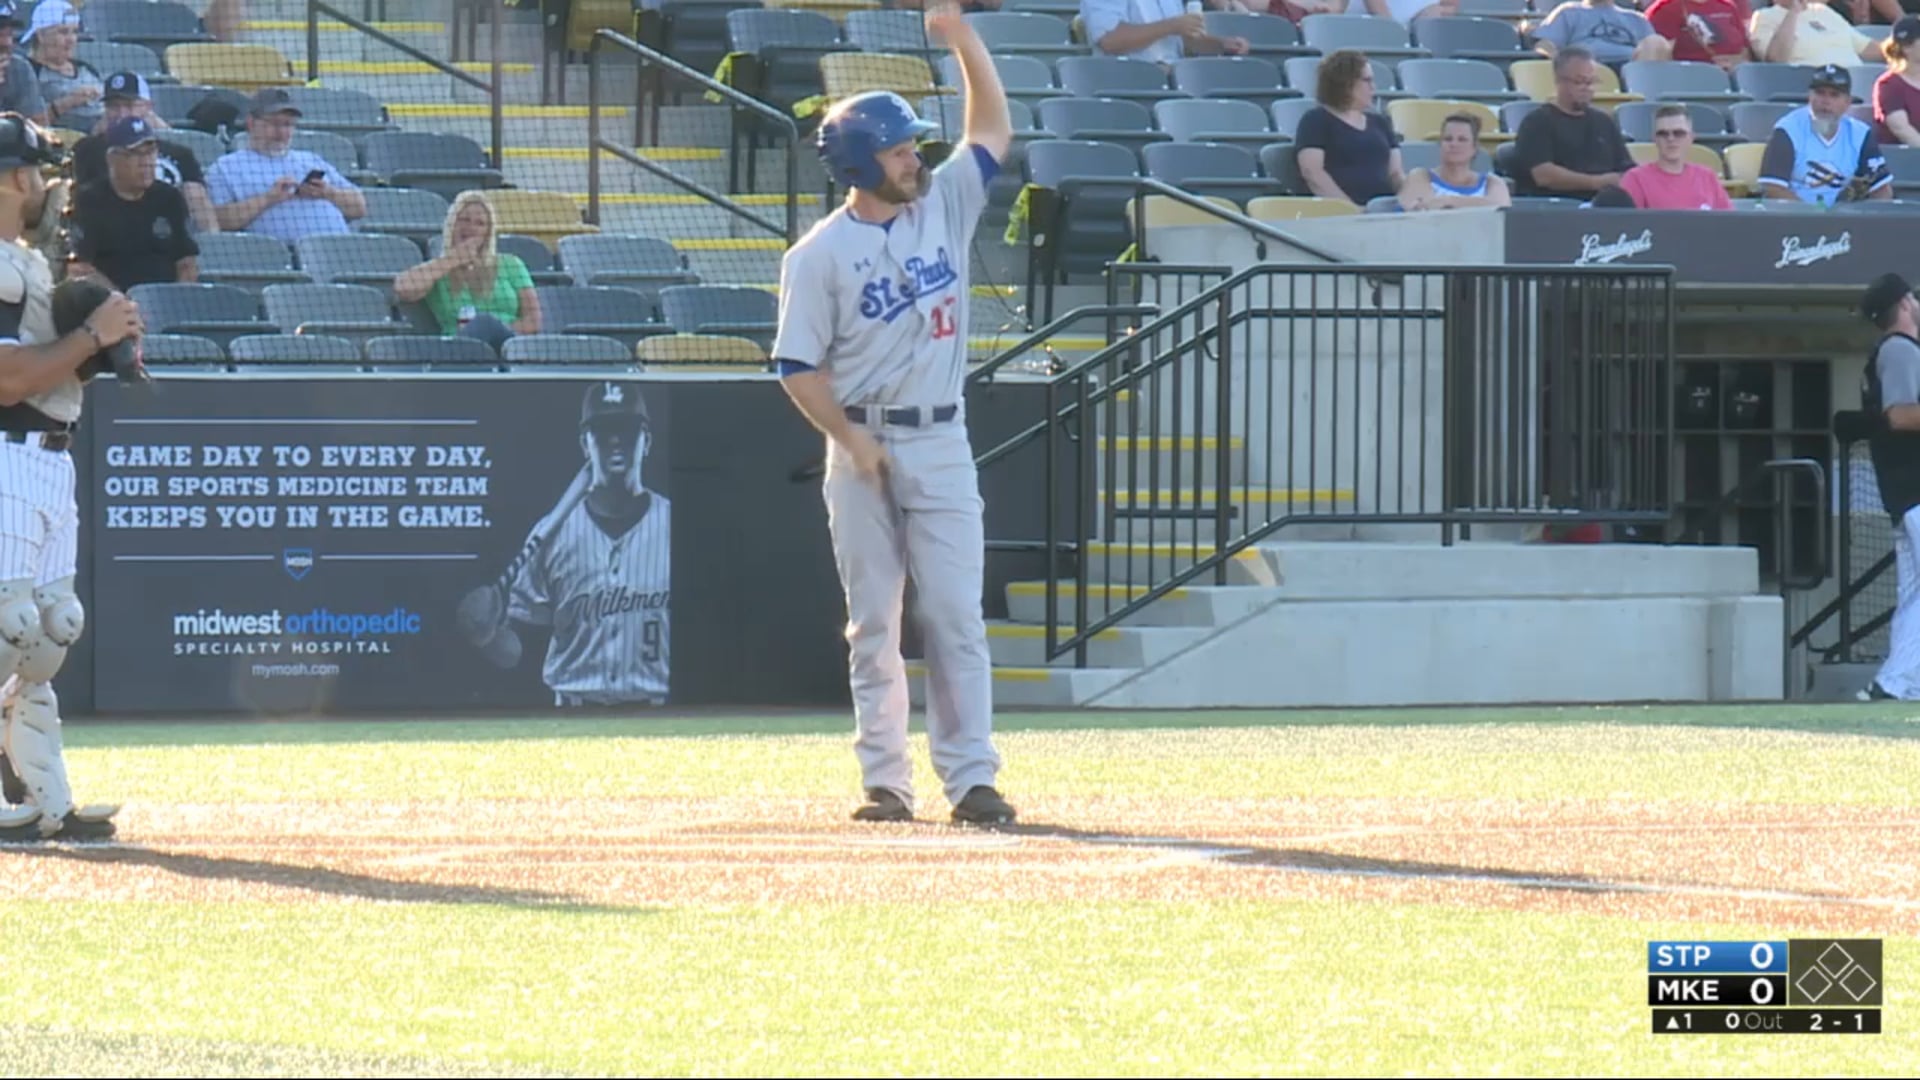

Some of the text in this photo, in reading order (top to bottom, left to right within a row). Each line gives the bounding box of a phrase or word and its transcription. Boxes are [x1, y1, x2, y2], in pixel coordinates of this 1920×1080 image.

[106, 445, 492, 469] GAME DAY TO EVERY DAY,
[104, 476, 488, 497] OUR SPORTS MEDICINE TEAM
[106, 505, 492, 528] KEEPS YOU IN THE GAME.
[174, 608, 421, 638] midwest orthopedic
[174, 641, 391, 655] SPECIALTY HOSPITAL
[642, 621, 660, 662] 9
[252, 662, 340, 678] mymosh.com
